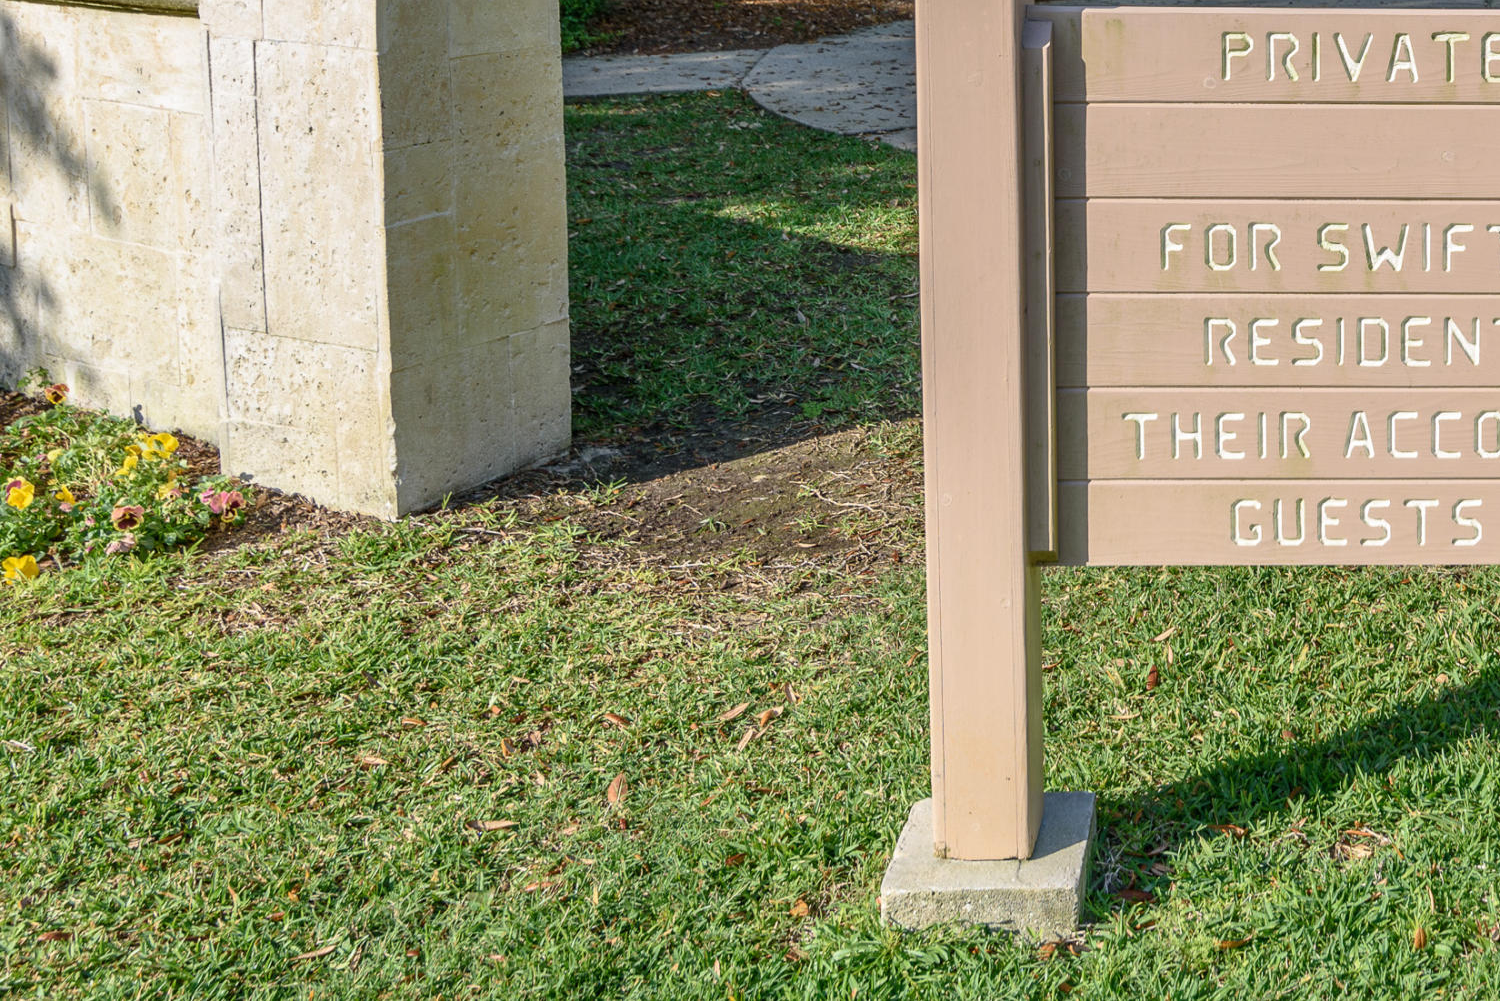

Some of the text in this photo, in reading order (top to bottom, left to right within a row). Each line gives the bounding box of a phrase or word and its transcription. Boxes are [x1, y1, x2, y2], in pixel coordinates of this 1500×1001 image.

[1160, 222, 1283, 273] FOR
[1122, 411, 1313, 461] THEIR
[1230, 498, 1484, 548] GUESTS
